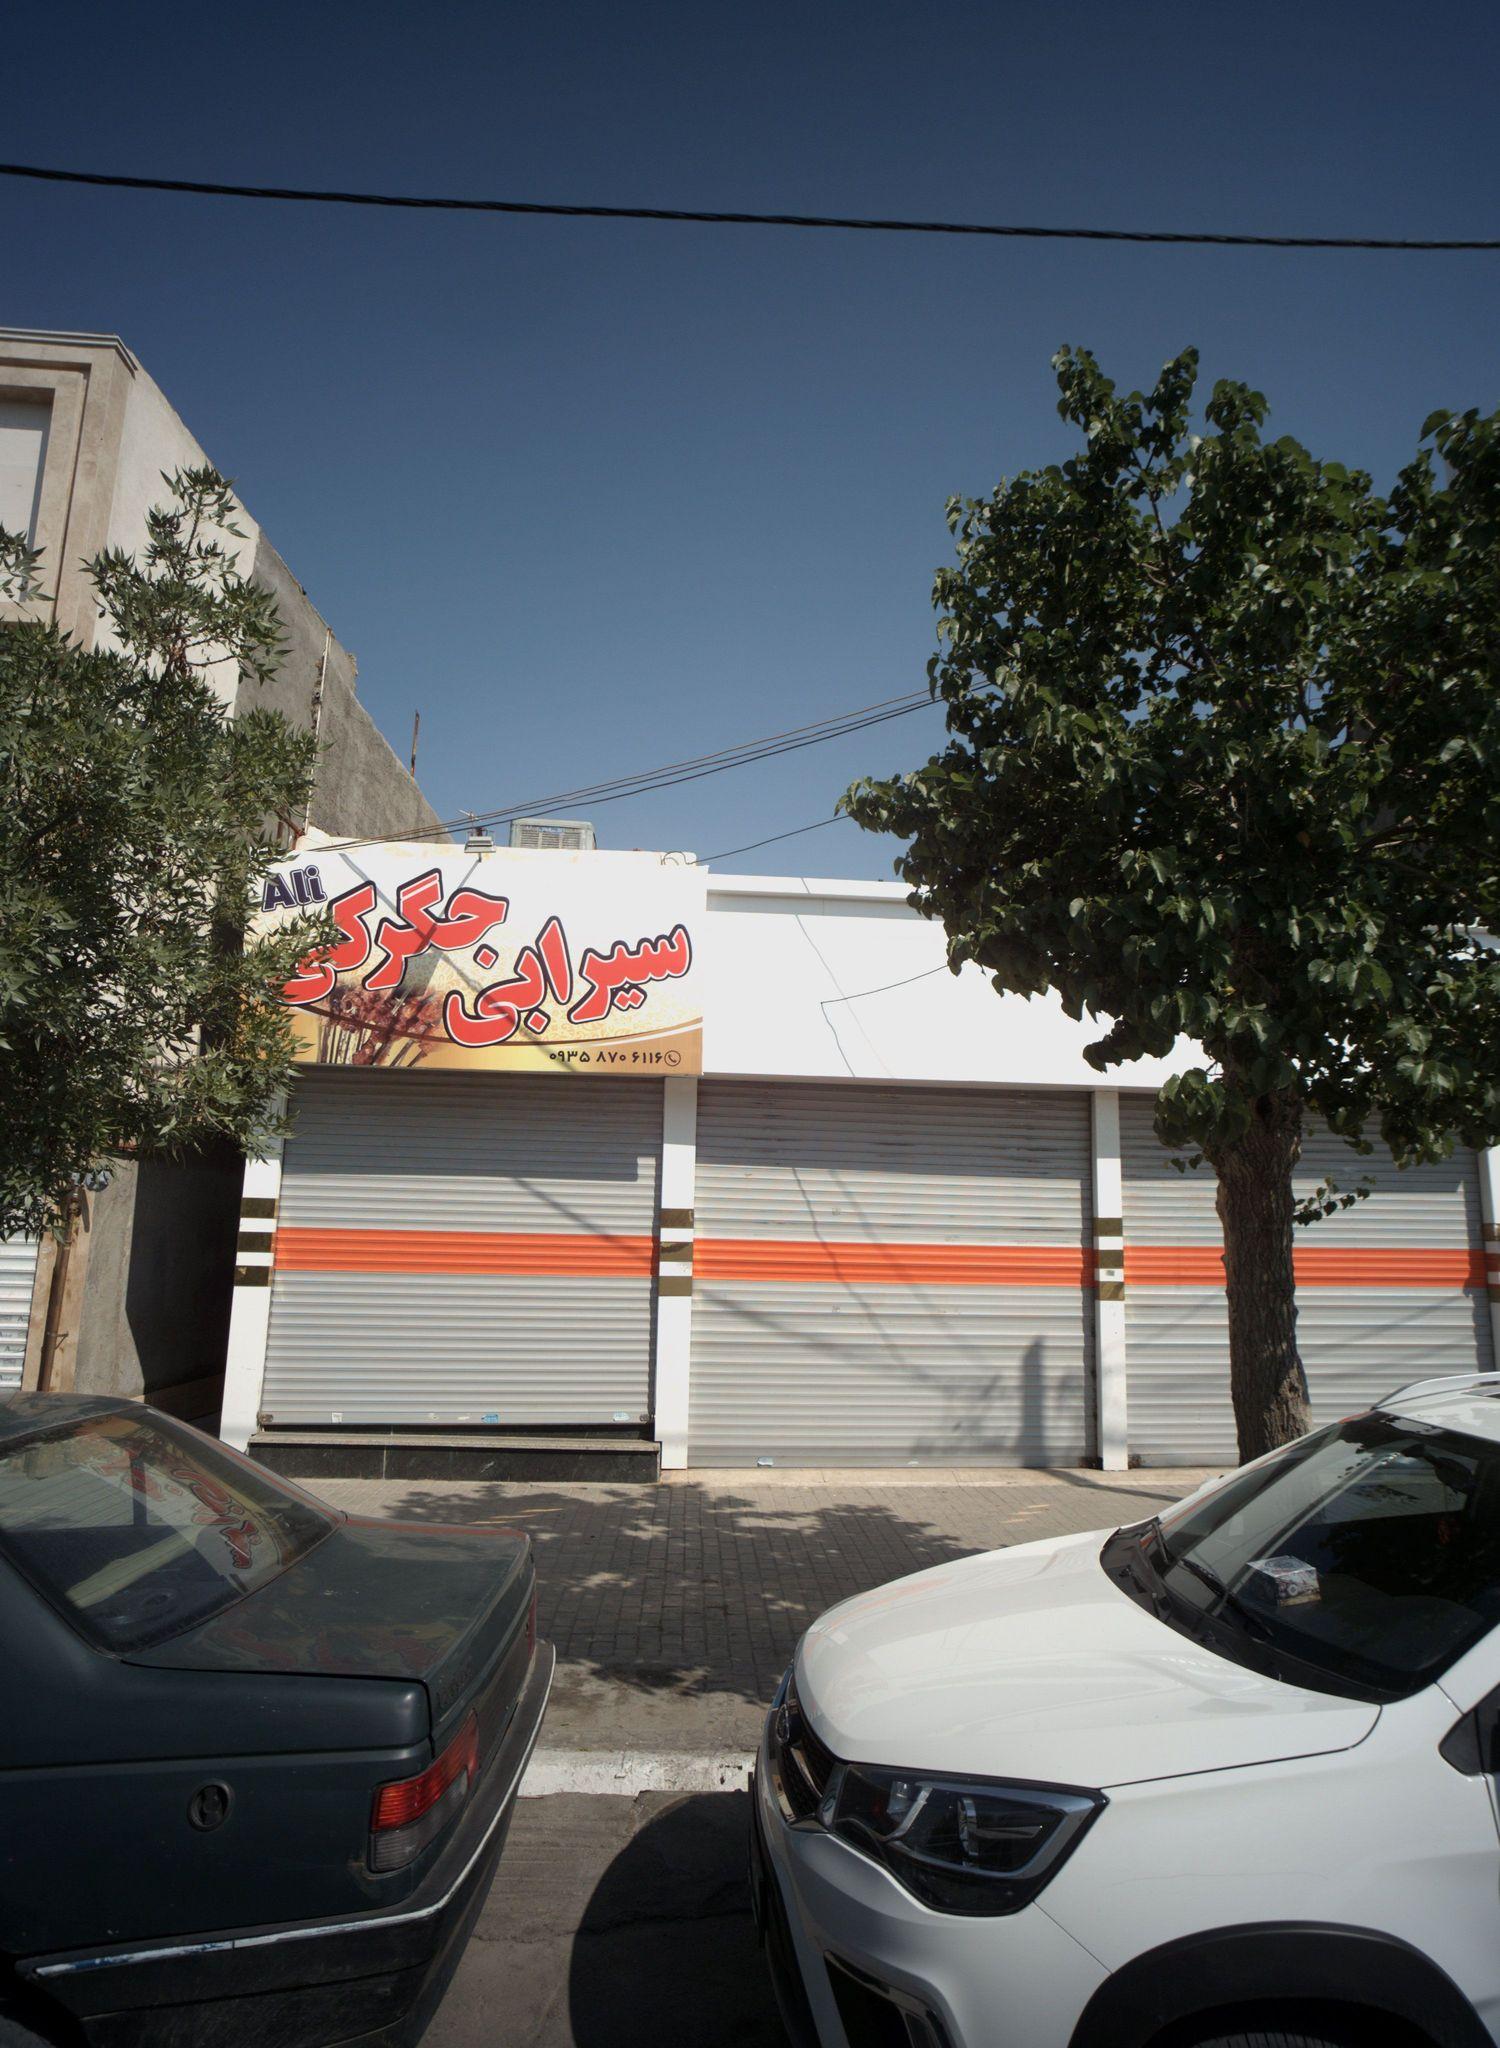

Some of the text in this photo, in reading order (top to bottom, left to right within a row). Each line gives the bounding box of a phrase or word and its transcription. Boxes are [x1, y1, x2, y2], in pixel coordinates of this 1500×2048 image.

[261, 865, 328, 912] Ali
[443, 916, 692, 1048] سیرابی
[549, 1050, 663, 1064] ۰۹۳۵ ۸۷۰ ۶۱۱۶
